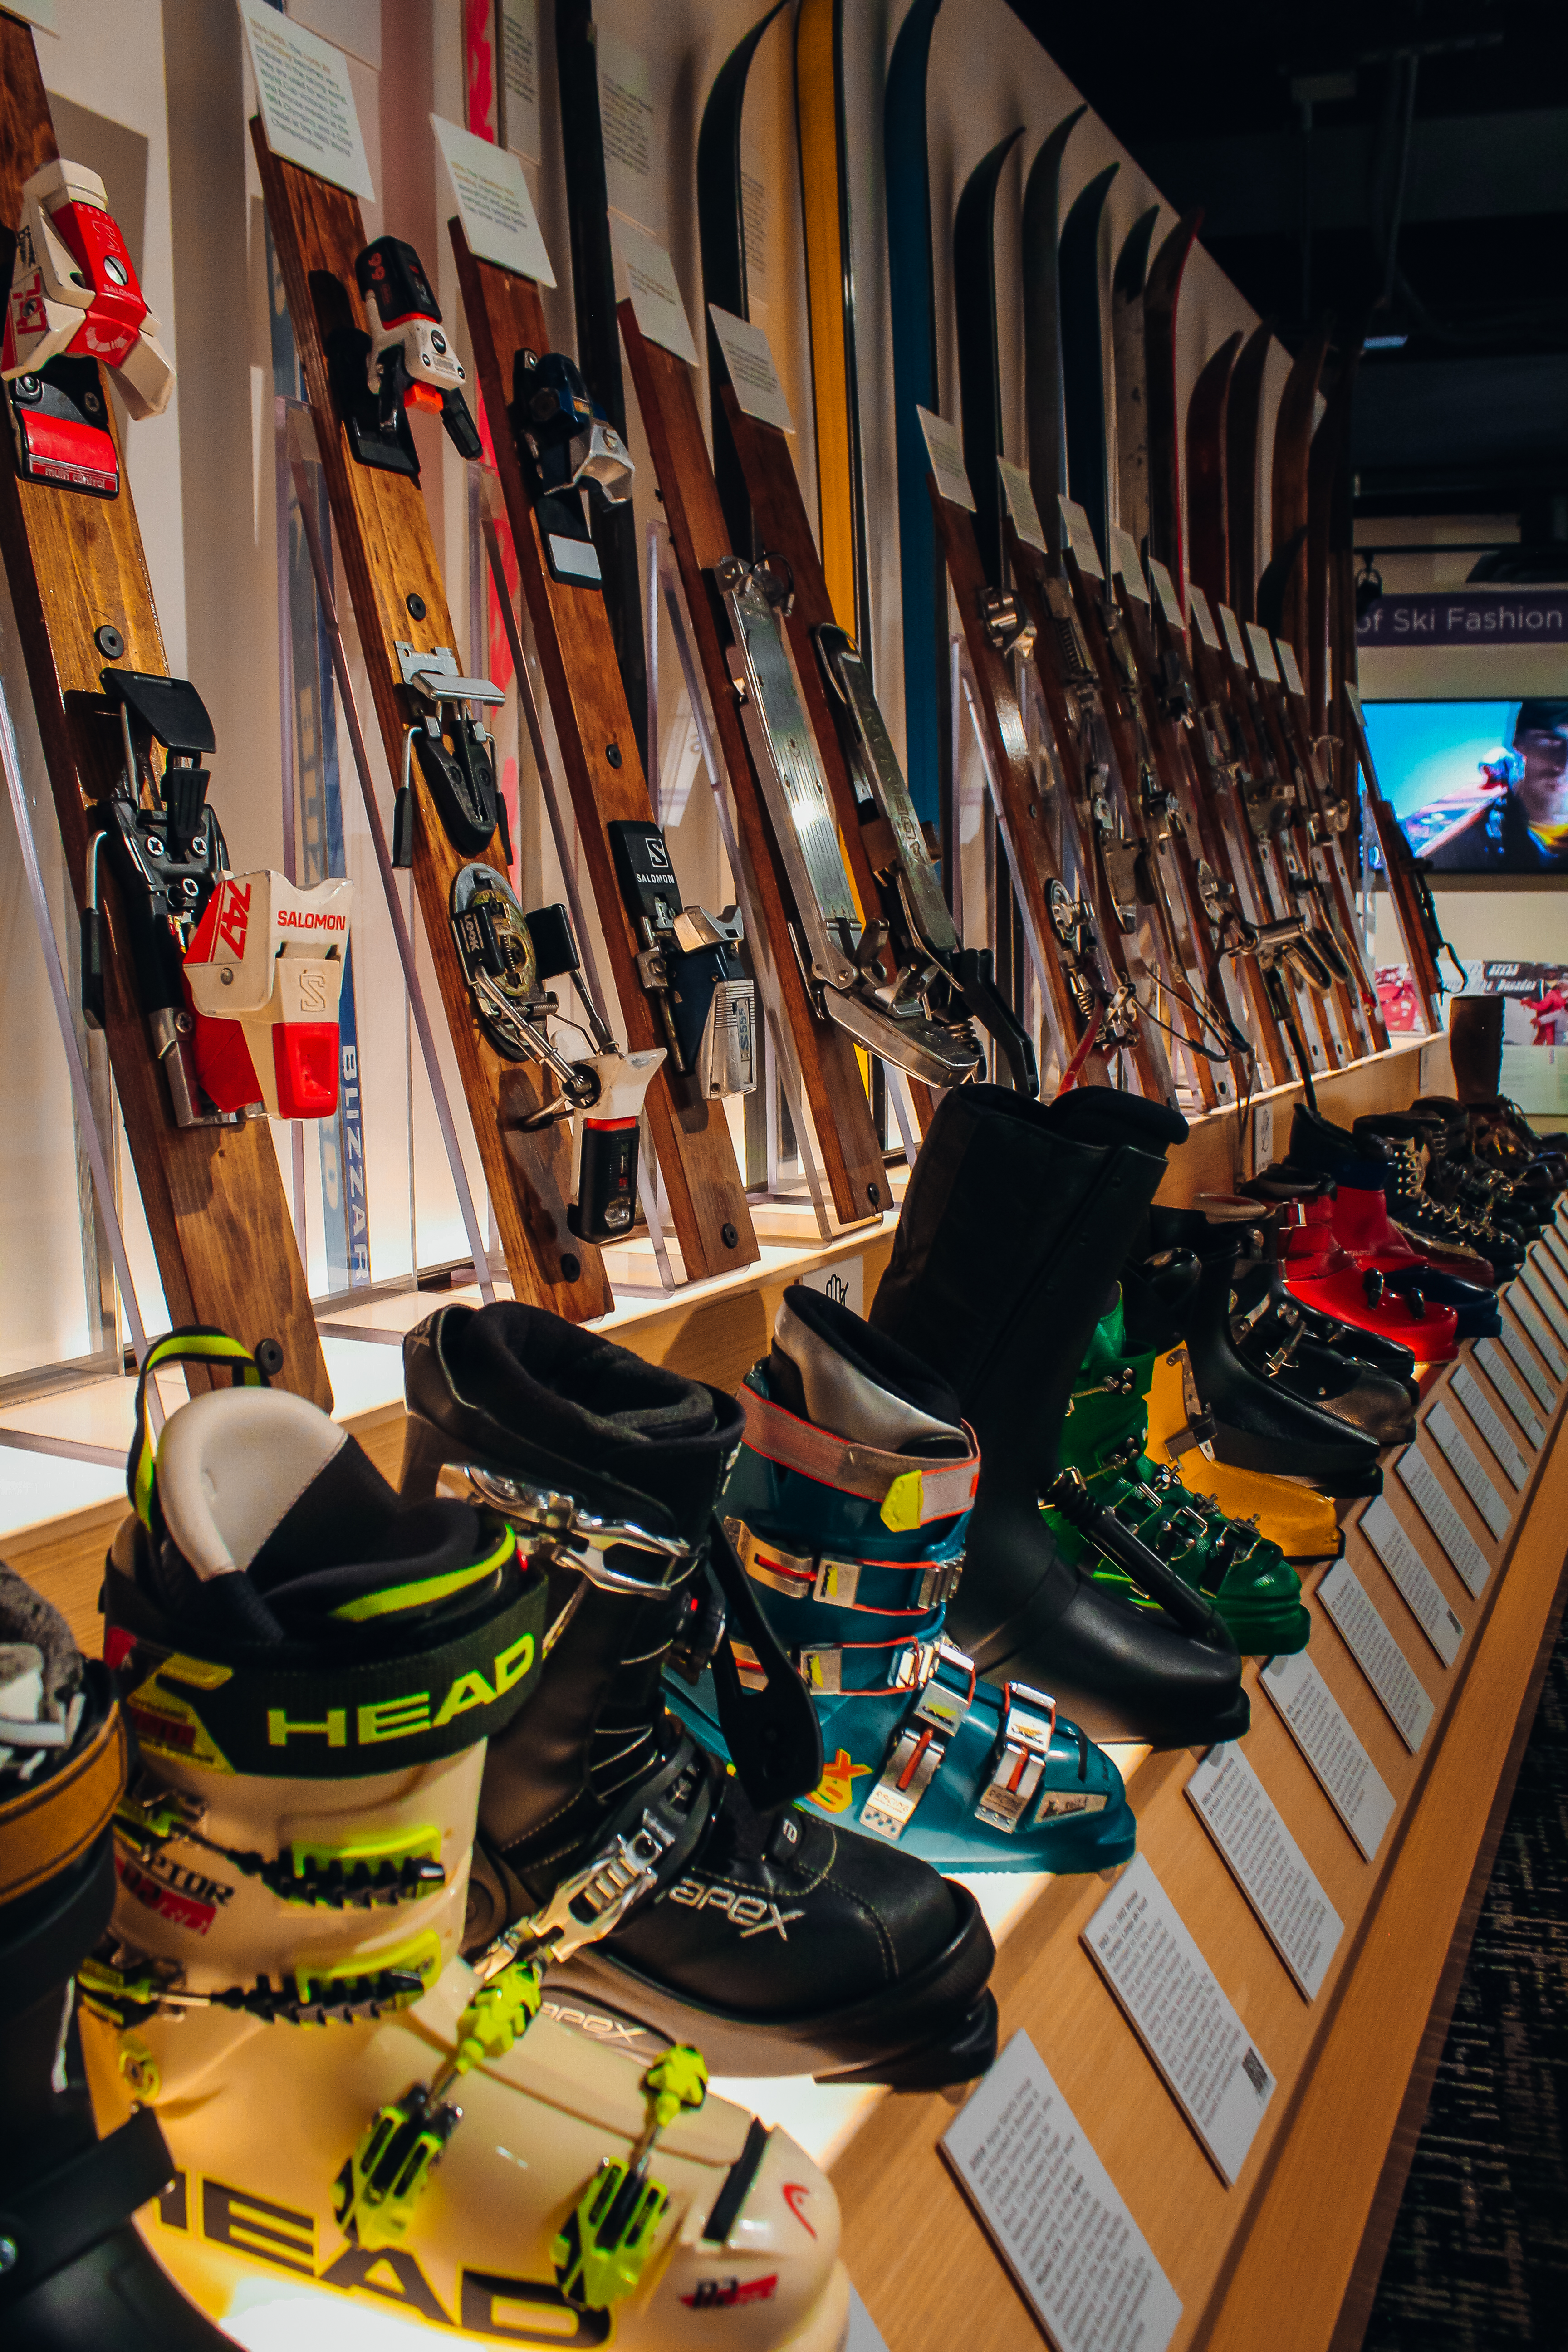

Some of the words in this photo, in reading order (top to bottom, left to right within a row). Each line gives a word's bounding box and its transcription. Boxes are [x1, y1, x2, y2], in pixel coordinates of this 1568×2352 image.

[45, 467, 69, 480] multi
[1356, 608, 1382, 633] of
[1394, 608, 1436, 632] Ski
[1448, 605, 1563, 630] Fashion
[636, 872, 675, 884] SALOMON
[219, 880, 252, 960] 747
[277, 910, 346, 931] SALOMON
[464, 915, 479, 951] LOOK
[267, 1631, 536, 1747] HEAD
